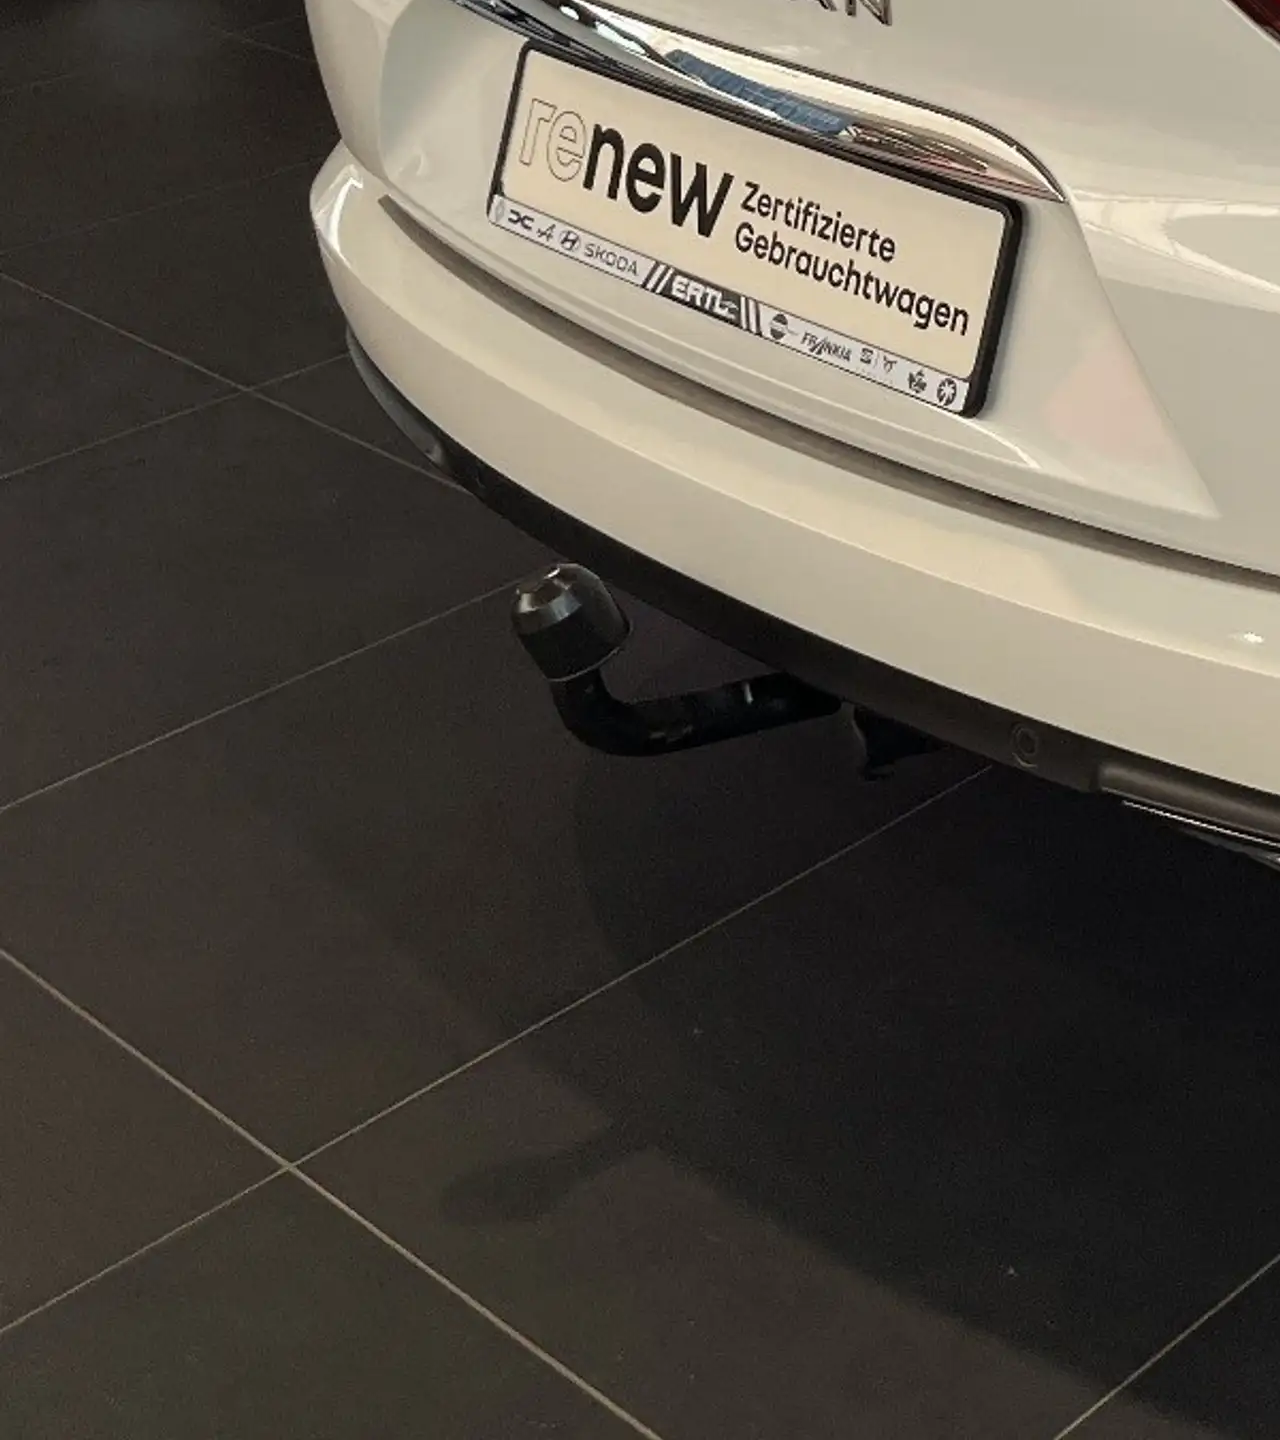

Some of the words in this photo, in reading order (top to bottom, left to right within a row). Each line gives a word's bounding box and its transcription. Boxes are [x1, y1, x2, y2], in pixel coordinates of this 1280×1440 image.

[518, 97, 735, 238] renew
[740, 180, 896, 263] Zertifizierte
[735, 221, 970, 336] Gebrauchtwagen
